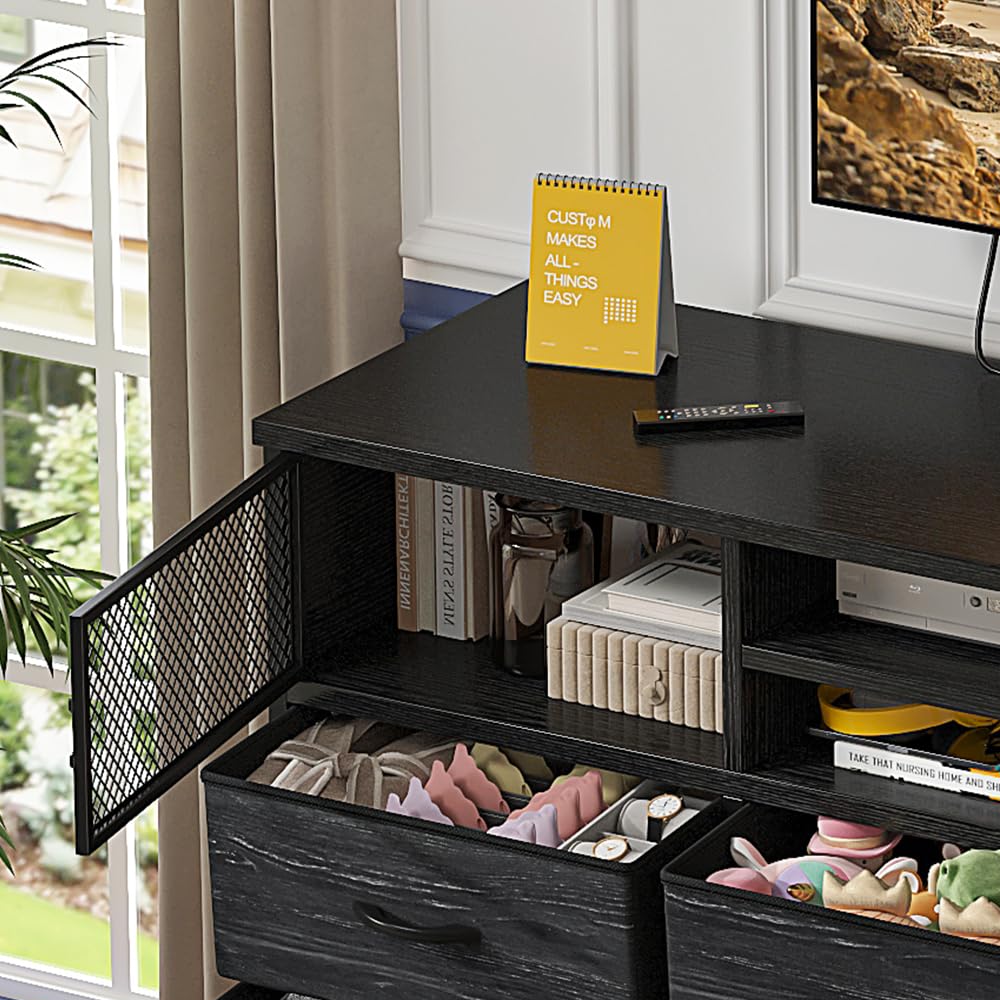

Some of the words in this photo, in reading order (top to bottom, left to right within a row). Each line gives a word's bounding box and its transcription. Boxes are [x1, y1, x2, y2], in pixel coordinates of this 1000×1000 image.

[546, 232, 597, 249] MAKES
[544, 272, 598, 290] THINGS
[543, 290, 582, 307] EASY
[848, 752, 869, 764] TAKE
[872, 756, 893, 769] THAT
[896, 762, 936, 778] NURSING
[938, 771, 962, 785] HOME
[965, 776, 984, 788] AND
